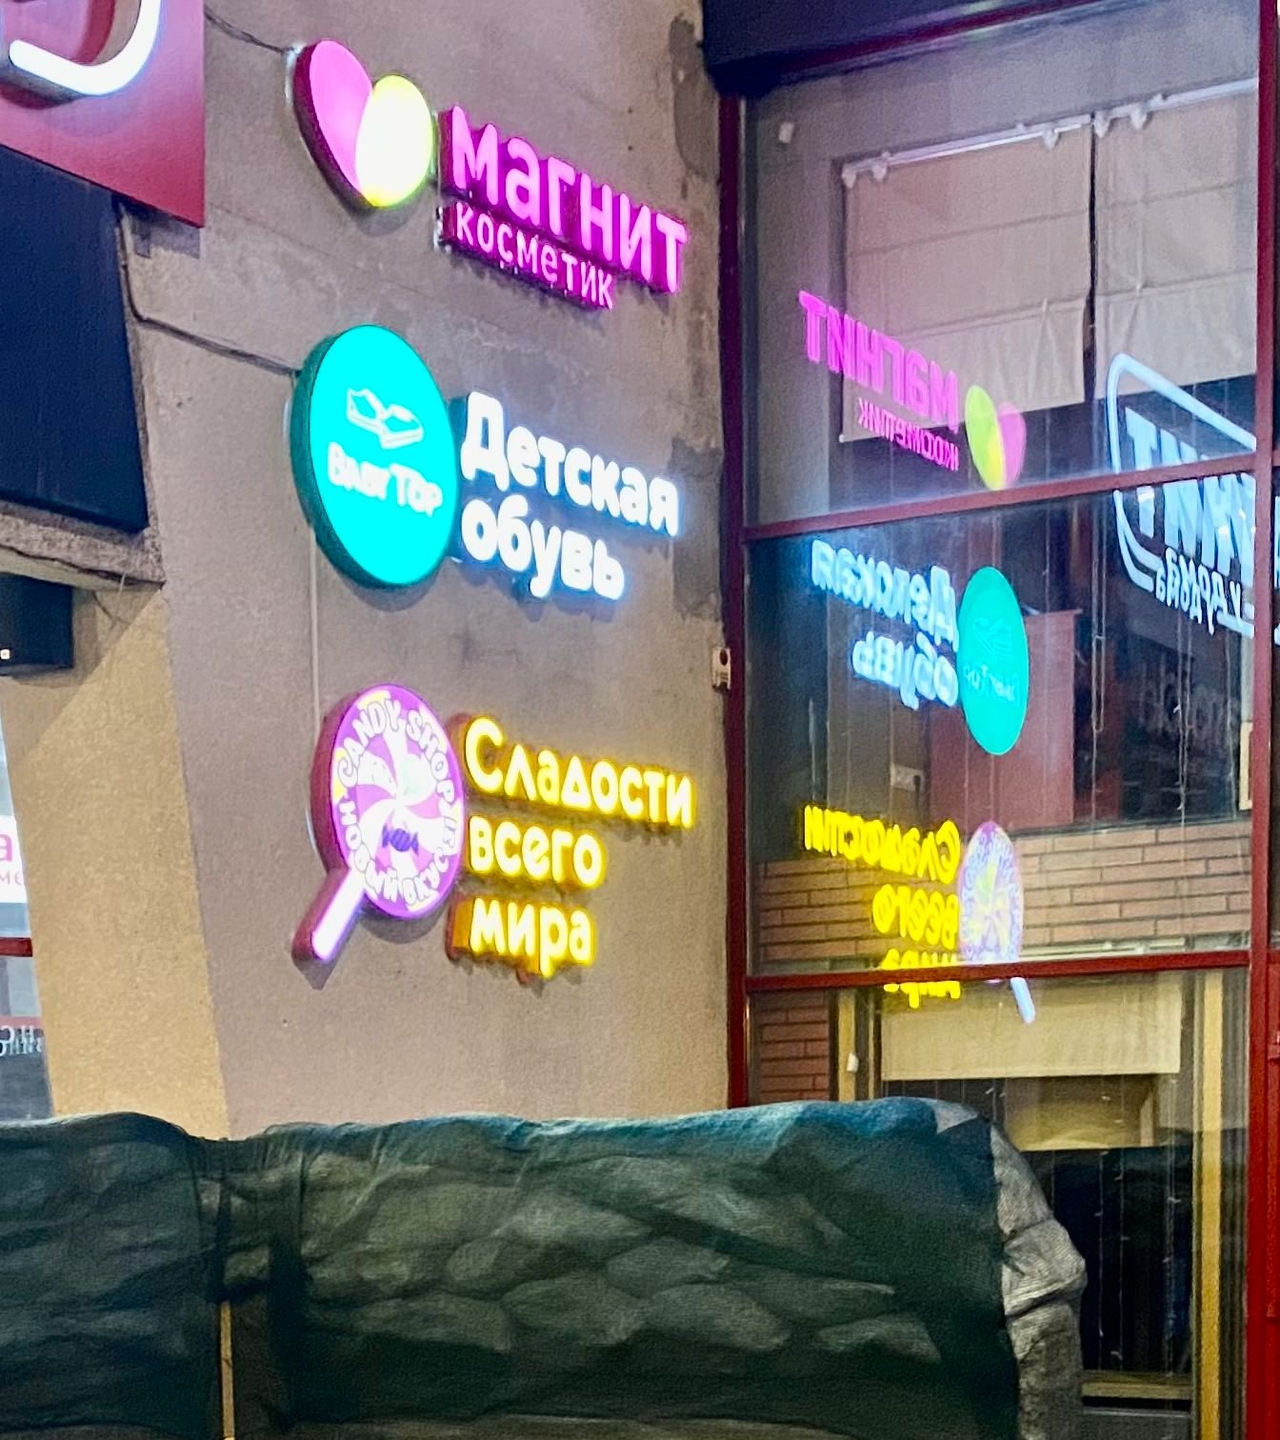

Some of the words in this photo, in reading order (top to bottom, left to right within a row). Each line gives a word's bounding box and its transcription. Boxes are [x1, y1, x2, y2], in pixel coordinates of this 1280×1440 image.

[455, 201, 613, 310] косметик
[460, 390, 679, 537] Детская
[461, 494, 625, 600] обувь
[336, 697, 401, 788] CANDY
[406, 710, 455, 803] SHOP
[464, 717, 697, 829] Сладости
[468, 814, 606, 888] всего
[469, 897, 597, 978] мира
